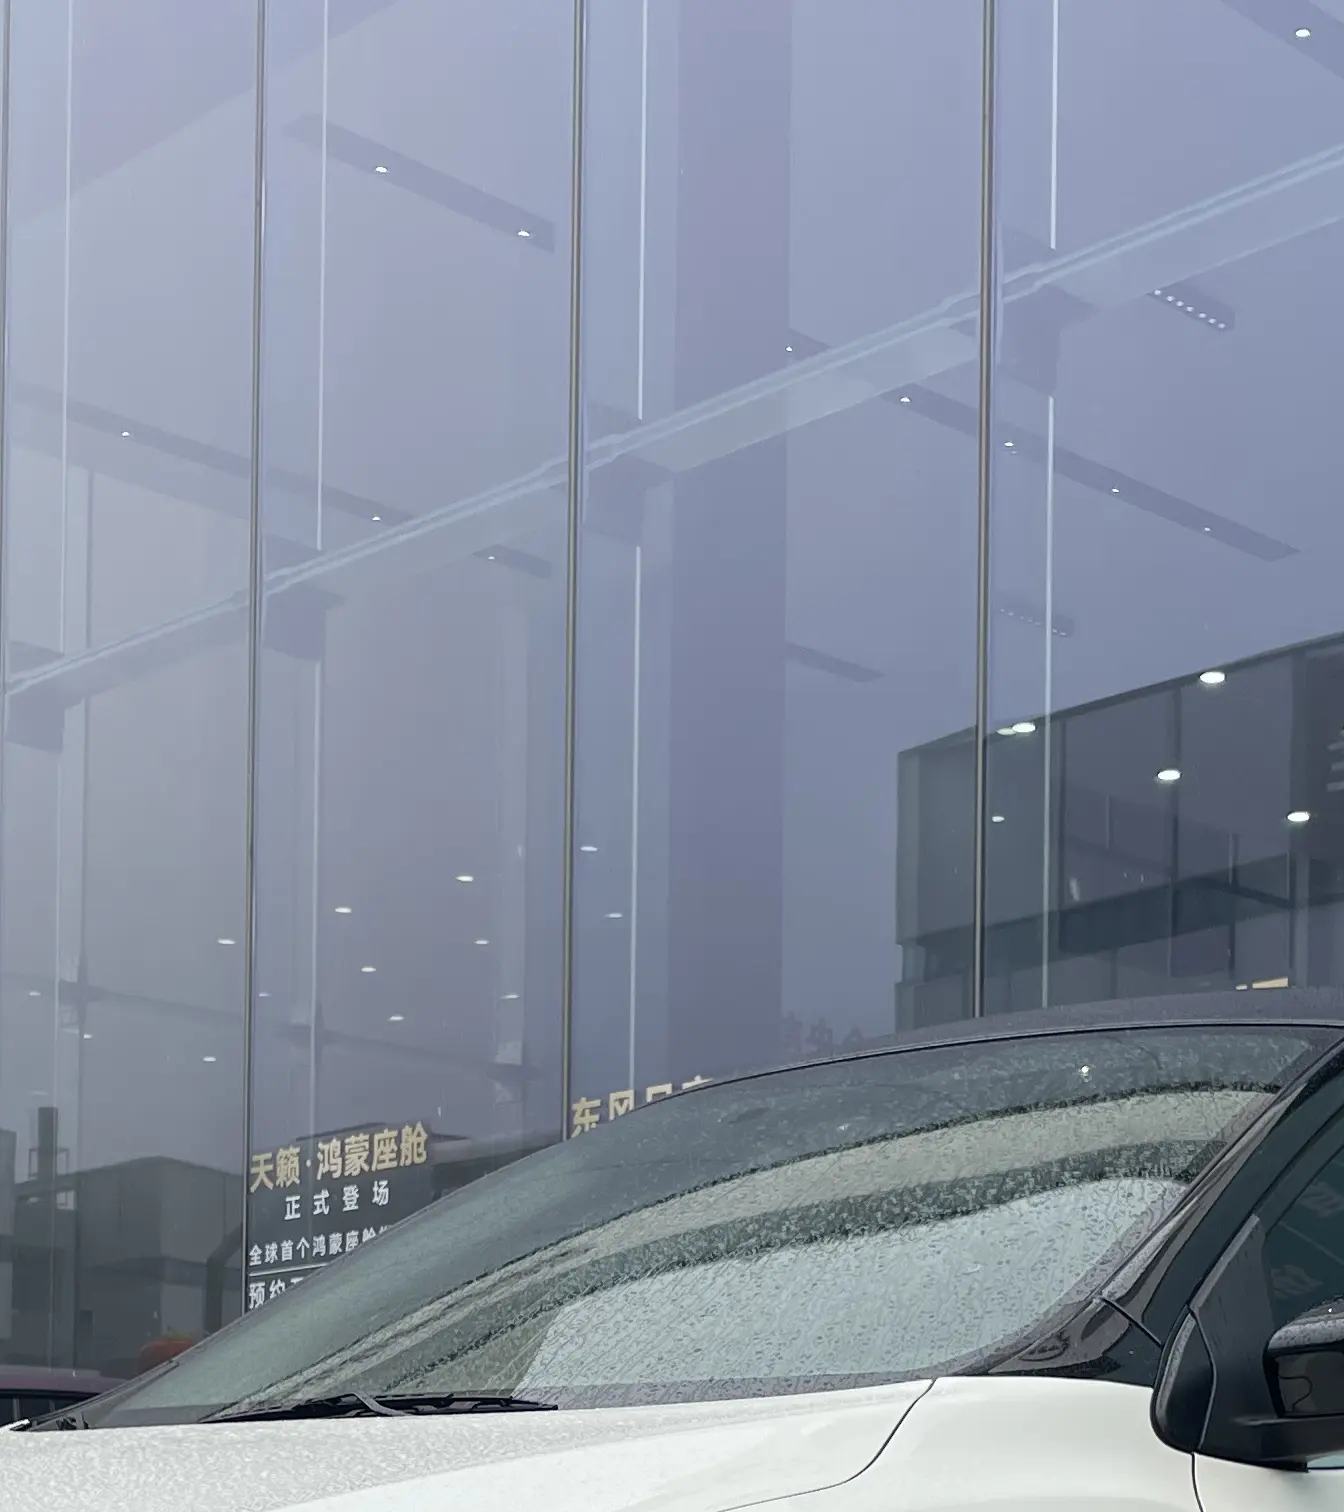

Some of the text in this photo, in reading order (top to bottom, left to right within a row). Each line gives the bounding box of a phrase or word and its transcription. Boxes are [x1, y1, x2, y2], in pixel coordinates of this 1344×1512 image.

[250, 1120, 428, 1193] 天籁·鸿蒙座舱
[284, 1179, 390, 1221] 正式登场
[248, 1226, 388, 1267] 全球首个鸿蒙座舱
[248, 1277, 304, 1310] 预约
